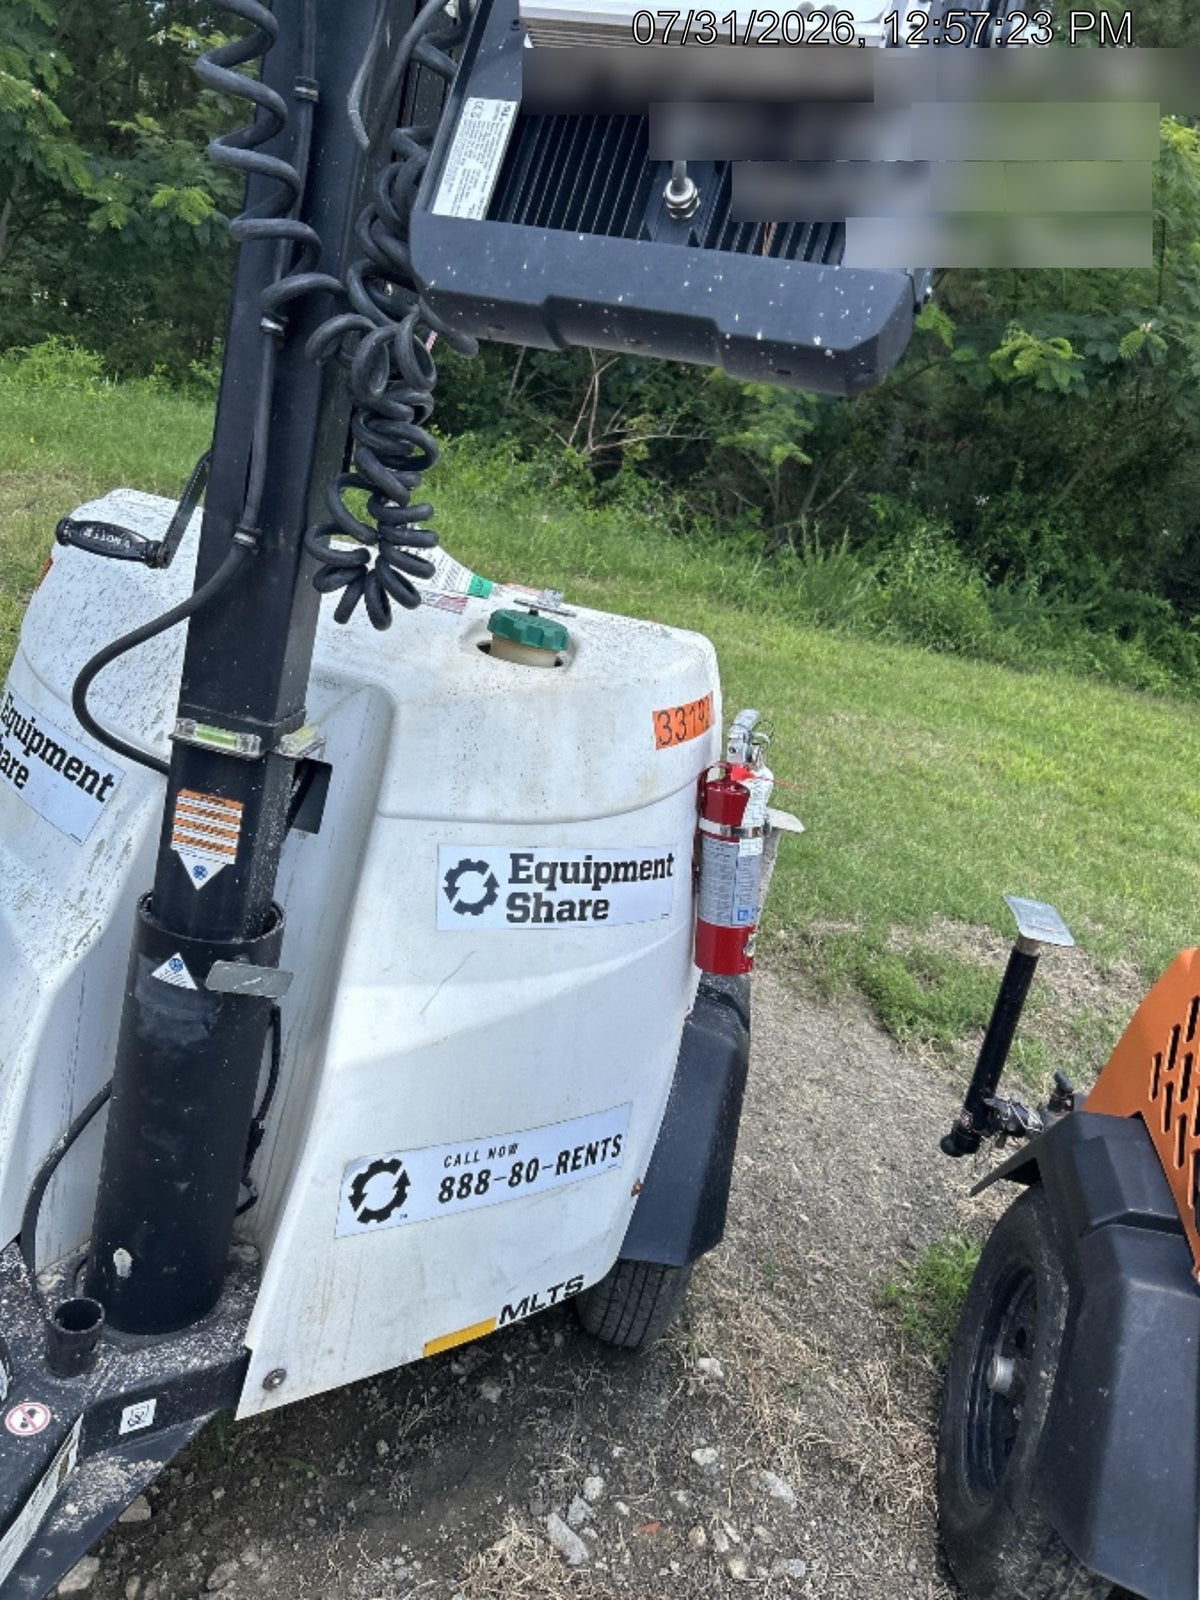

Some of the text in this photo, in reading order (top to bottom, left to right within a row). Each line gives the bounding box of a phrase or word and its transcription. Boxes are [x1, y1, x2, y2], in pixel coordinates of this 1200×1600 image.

[0, 733, 29, 790] are
[508, 852, 675, 891] Equipment
[506, 892, 609, 923] Share
[438, 1133, 623, 1204] 888-80-RENTS
[444, 1142, 519, 1168] CALL NOW
[499, 1273, 584, 1325] MLTS
